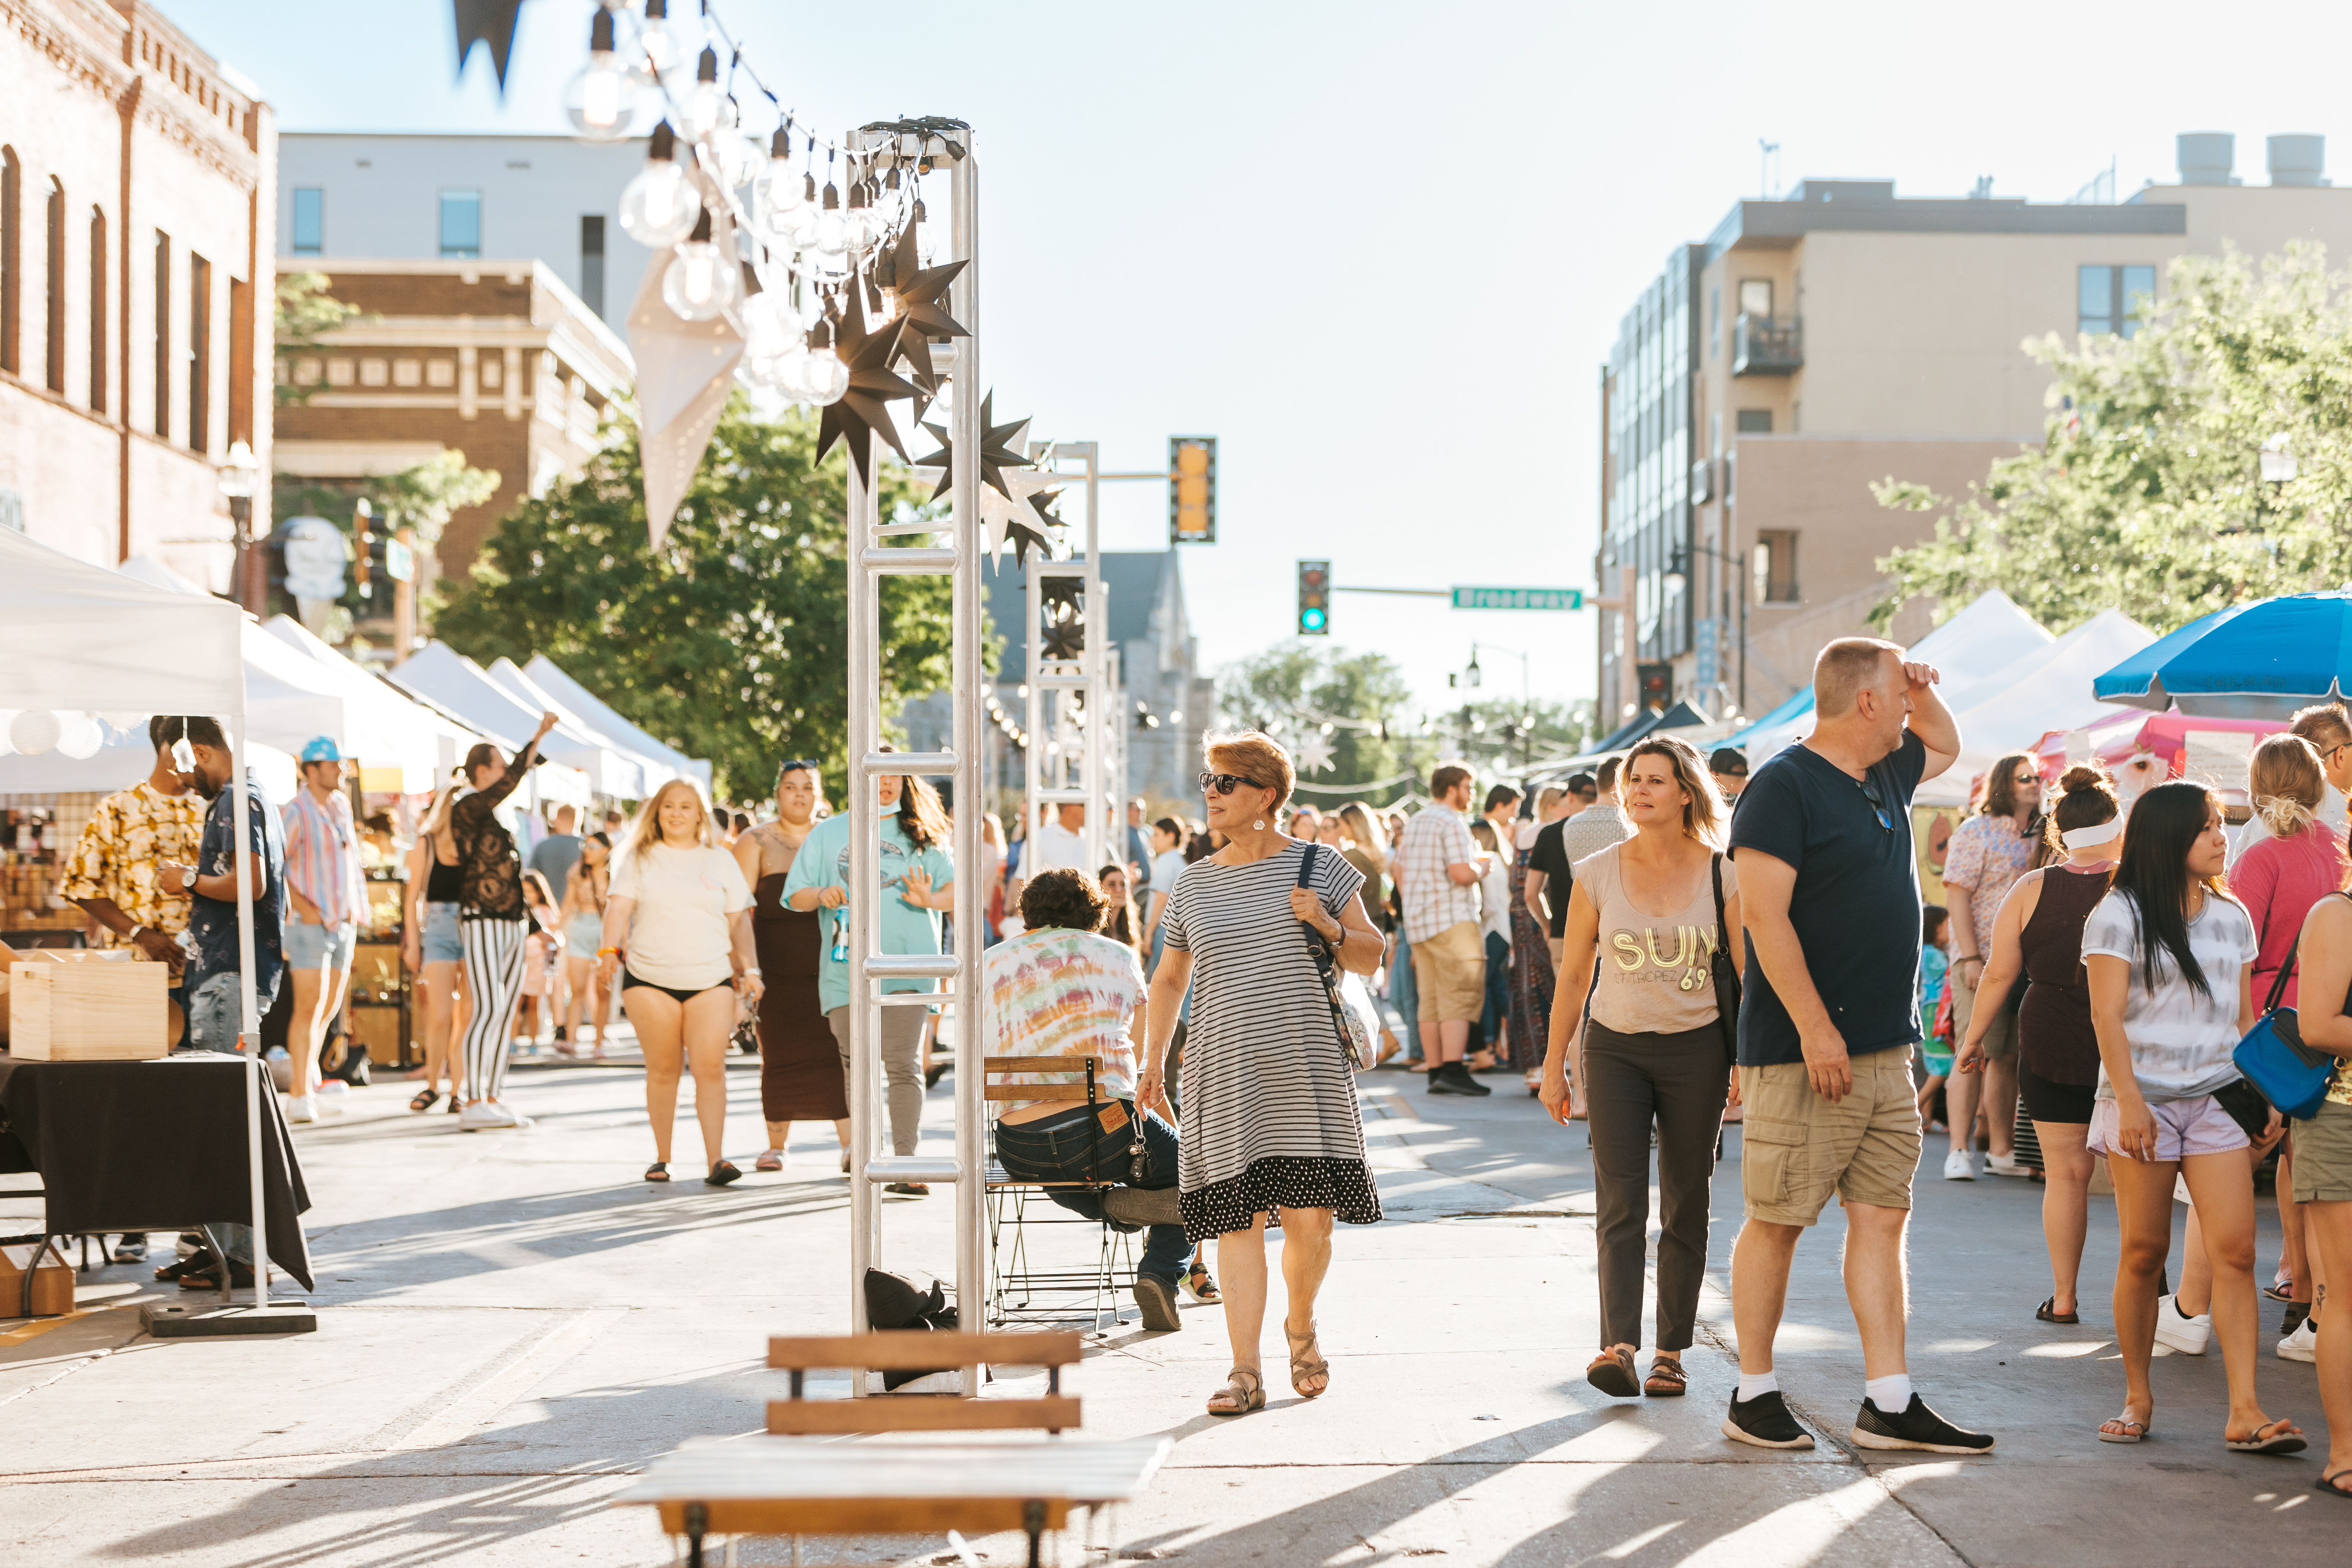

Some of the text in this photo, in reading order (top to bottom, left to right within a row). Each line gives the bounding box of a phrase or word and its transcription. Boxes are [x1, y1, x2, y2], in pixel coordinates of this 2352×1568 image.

[1458, 589, 1576, 610] Broadway
[2206, 675, 2287, 689] CHOCOLATE
[1609, 924, 1716, 971] SUN
[1678, 966, 1709, 992] 69
